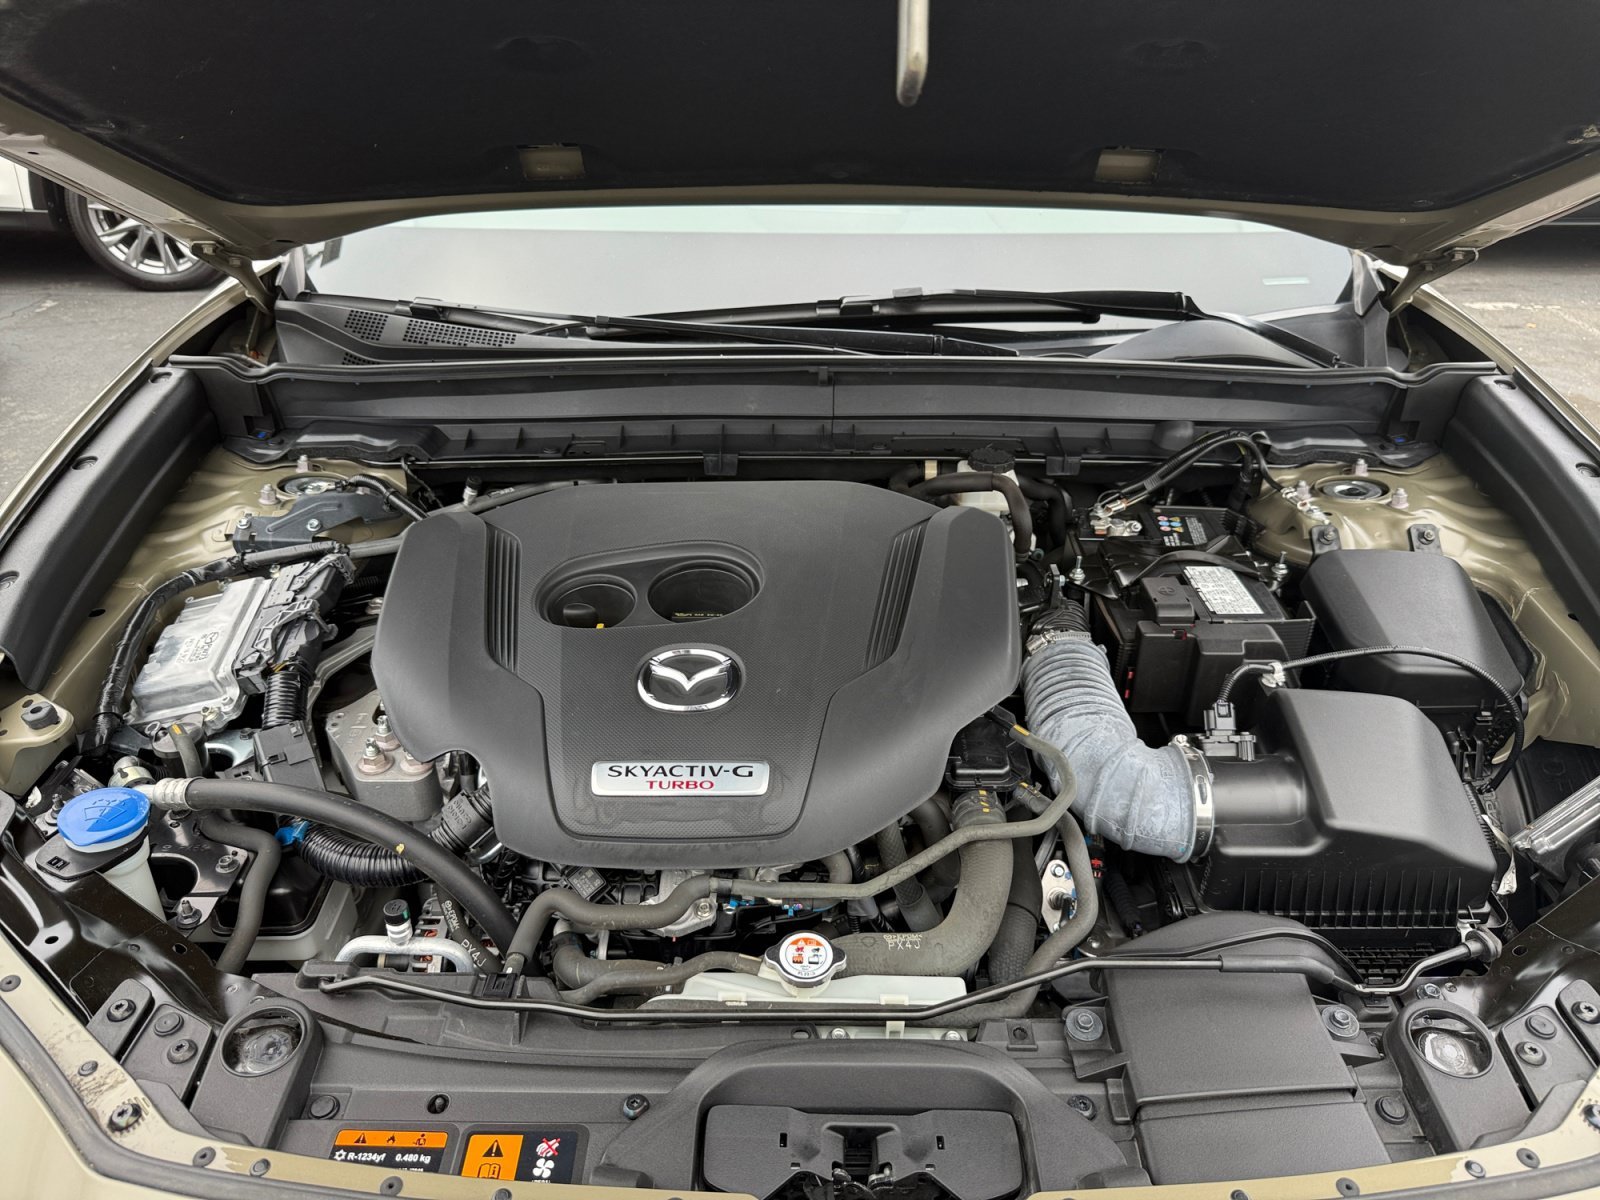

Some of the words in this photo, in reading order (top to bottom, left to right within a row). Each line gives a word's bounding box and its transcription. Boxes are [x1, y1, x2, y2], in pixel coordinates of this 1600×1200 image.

[607, 765, 753, 777] SKYACTIV-G
[646, 780, 714, 790] TURBO
[887, 939, 921, 950] PX4J
[347, 1152, 386, 1163] R-1234yf
[395, 1153, 419, 1162] 0.480
[419, 1153, 431, 1164] kg
